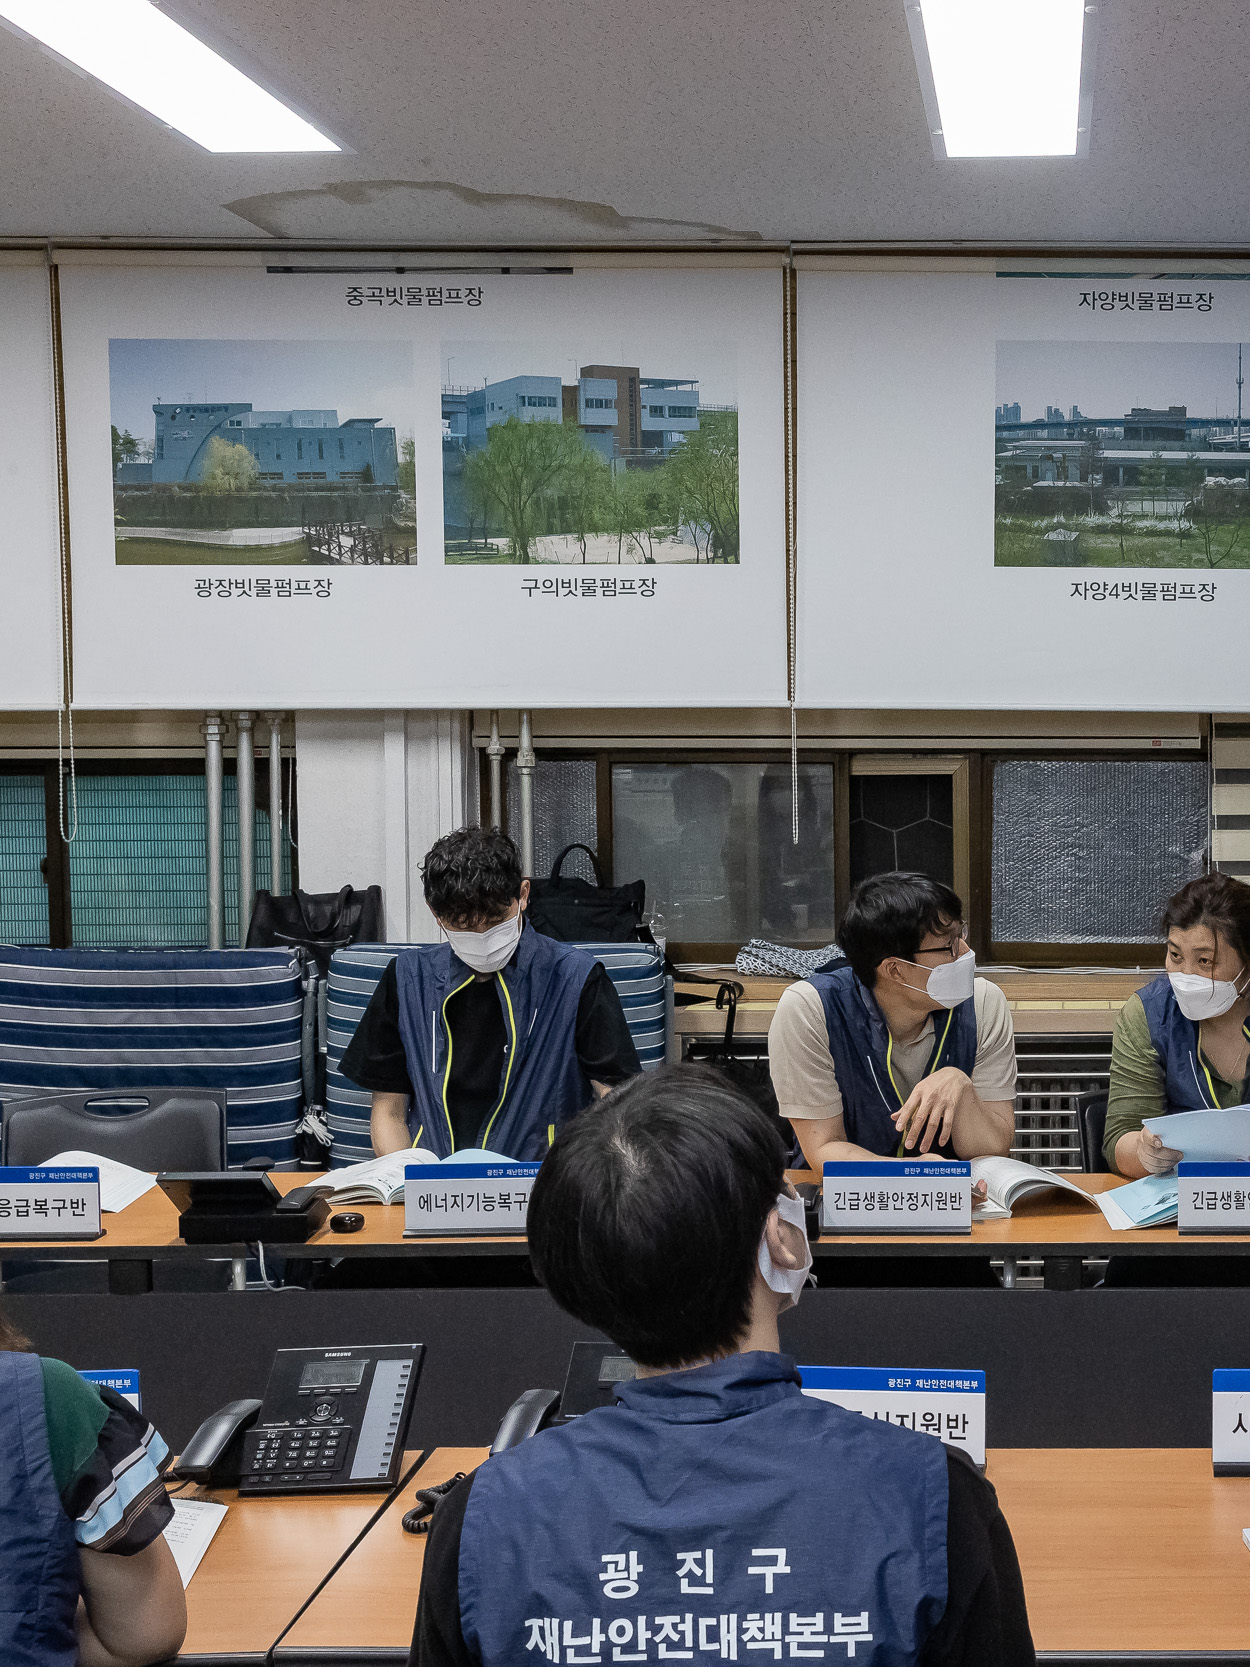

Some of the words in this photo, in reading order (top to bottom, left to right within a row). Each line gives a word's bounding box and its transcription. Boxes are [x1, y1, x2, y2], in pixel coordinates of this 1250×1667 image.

[345, 286, 484, 307] 중곡빗물펌프장
[1079, 290, 1215, 312] 자양빗물펌프장
[194, 577, 333, 598] 광장빗물펌프장
[520, 577, 658, 598] 구의빗물펌프장
[1070, 581, 1218, 602] 자양4빗물펌프장
[29, 1172, 46, 1180] 광진구
[48, 1172, 94, 1180] 재난안전대책본부
[486, 1168, 504, 1177] 광진구
[904, 1167, 921, 1175] 광진구
[923, 1167, 967, 1175] 재난안전대책본부
[0, 1198, 87, 1218] 응급복구반
[834, 1191, 963, 1212] 긴급생활안정지원반
[887, 1378, 912, 1388] 광진구
[915, 1379, 979, 1390] 재난안전대책본부
[524, 1611, 874, 1664] 재난안전대책본부
